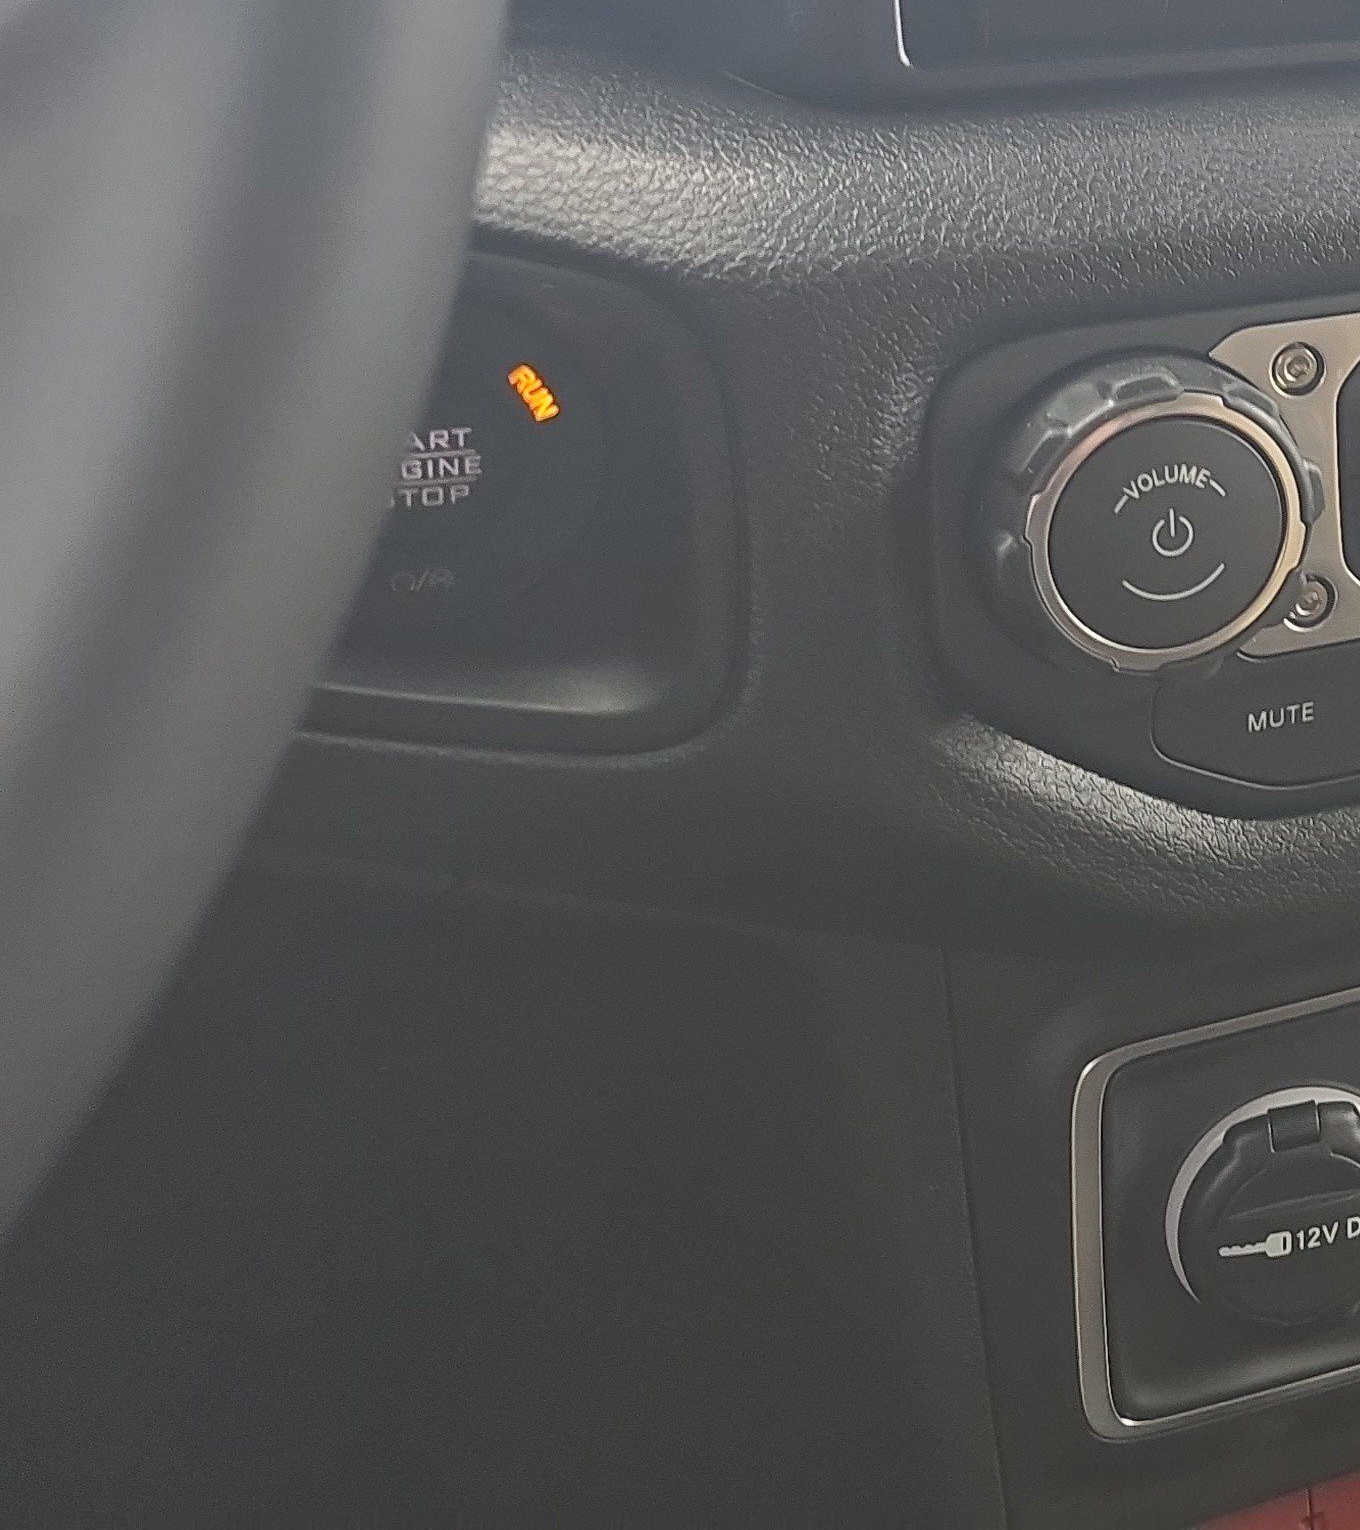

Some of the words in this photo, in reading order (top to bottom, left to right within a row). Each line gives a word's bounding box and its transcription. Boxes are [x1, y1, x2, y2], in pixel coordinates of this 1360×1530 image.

[508, 364, 560, 422] RUN
[400, 455, 482, 479] GINE
[391, 484, 469, 508] TOP
[1122, 466, 1211, 500] VOLUME
[1246, 700, 1316, 732] MUTE
[1294, 1223, 1340, 1252] 12V
